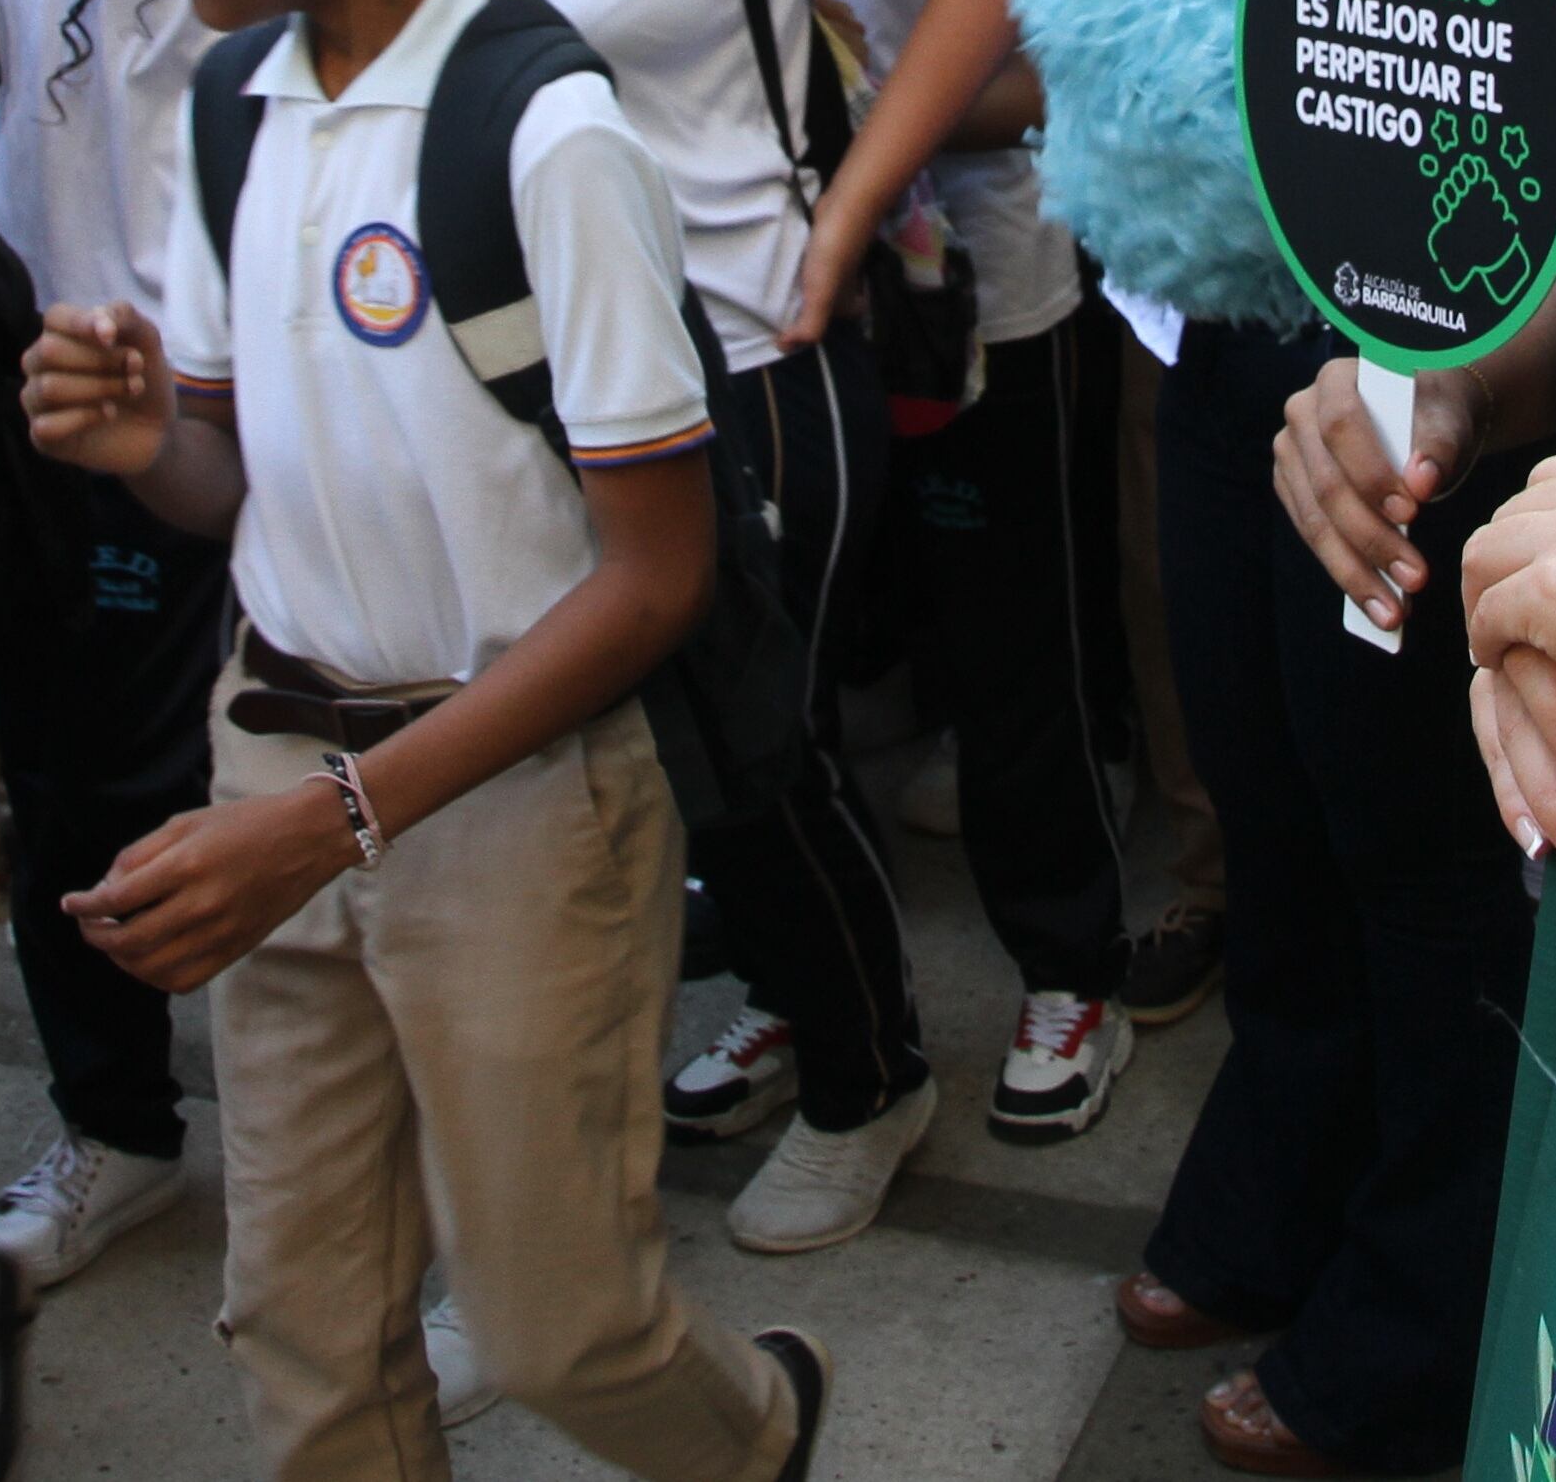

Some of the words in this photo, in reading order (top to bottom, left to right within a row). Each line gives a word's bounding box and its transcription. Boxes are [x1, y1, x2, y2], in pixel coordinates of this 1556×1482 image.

[1446, 14, 1513, 63] QUE
[1296, 37, 1461, 105] PERPETUAR
[1469, 71, 1503, 114] EL
[1296, 87, 1423, 148] CASTIGO
[1362, 286, 1466, 333] BARRANQUILLA
[1363, 273, 1405, 296] ALCALDÍA
[1408, 285, 1421, 300] DE
